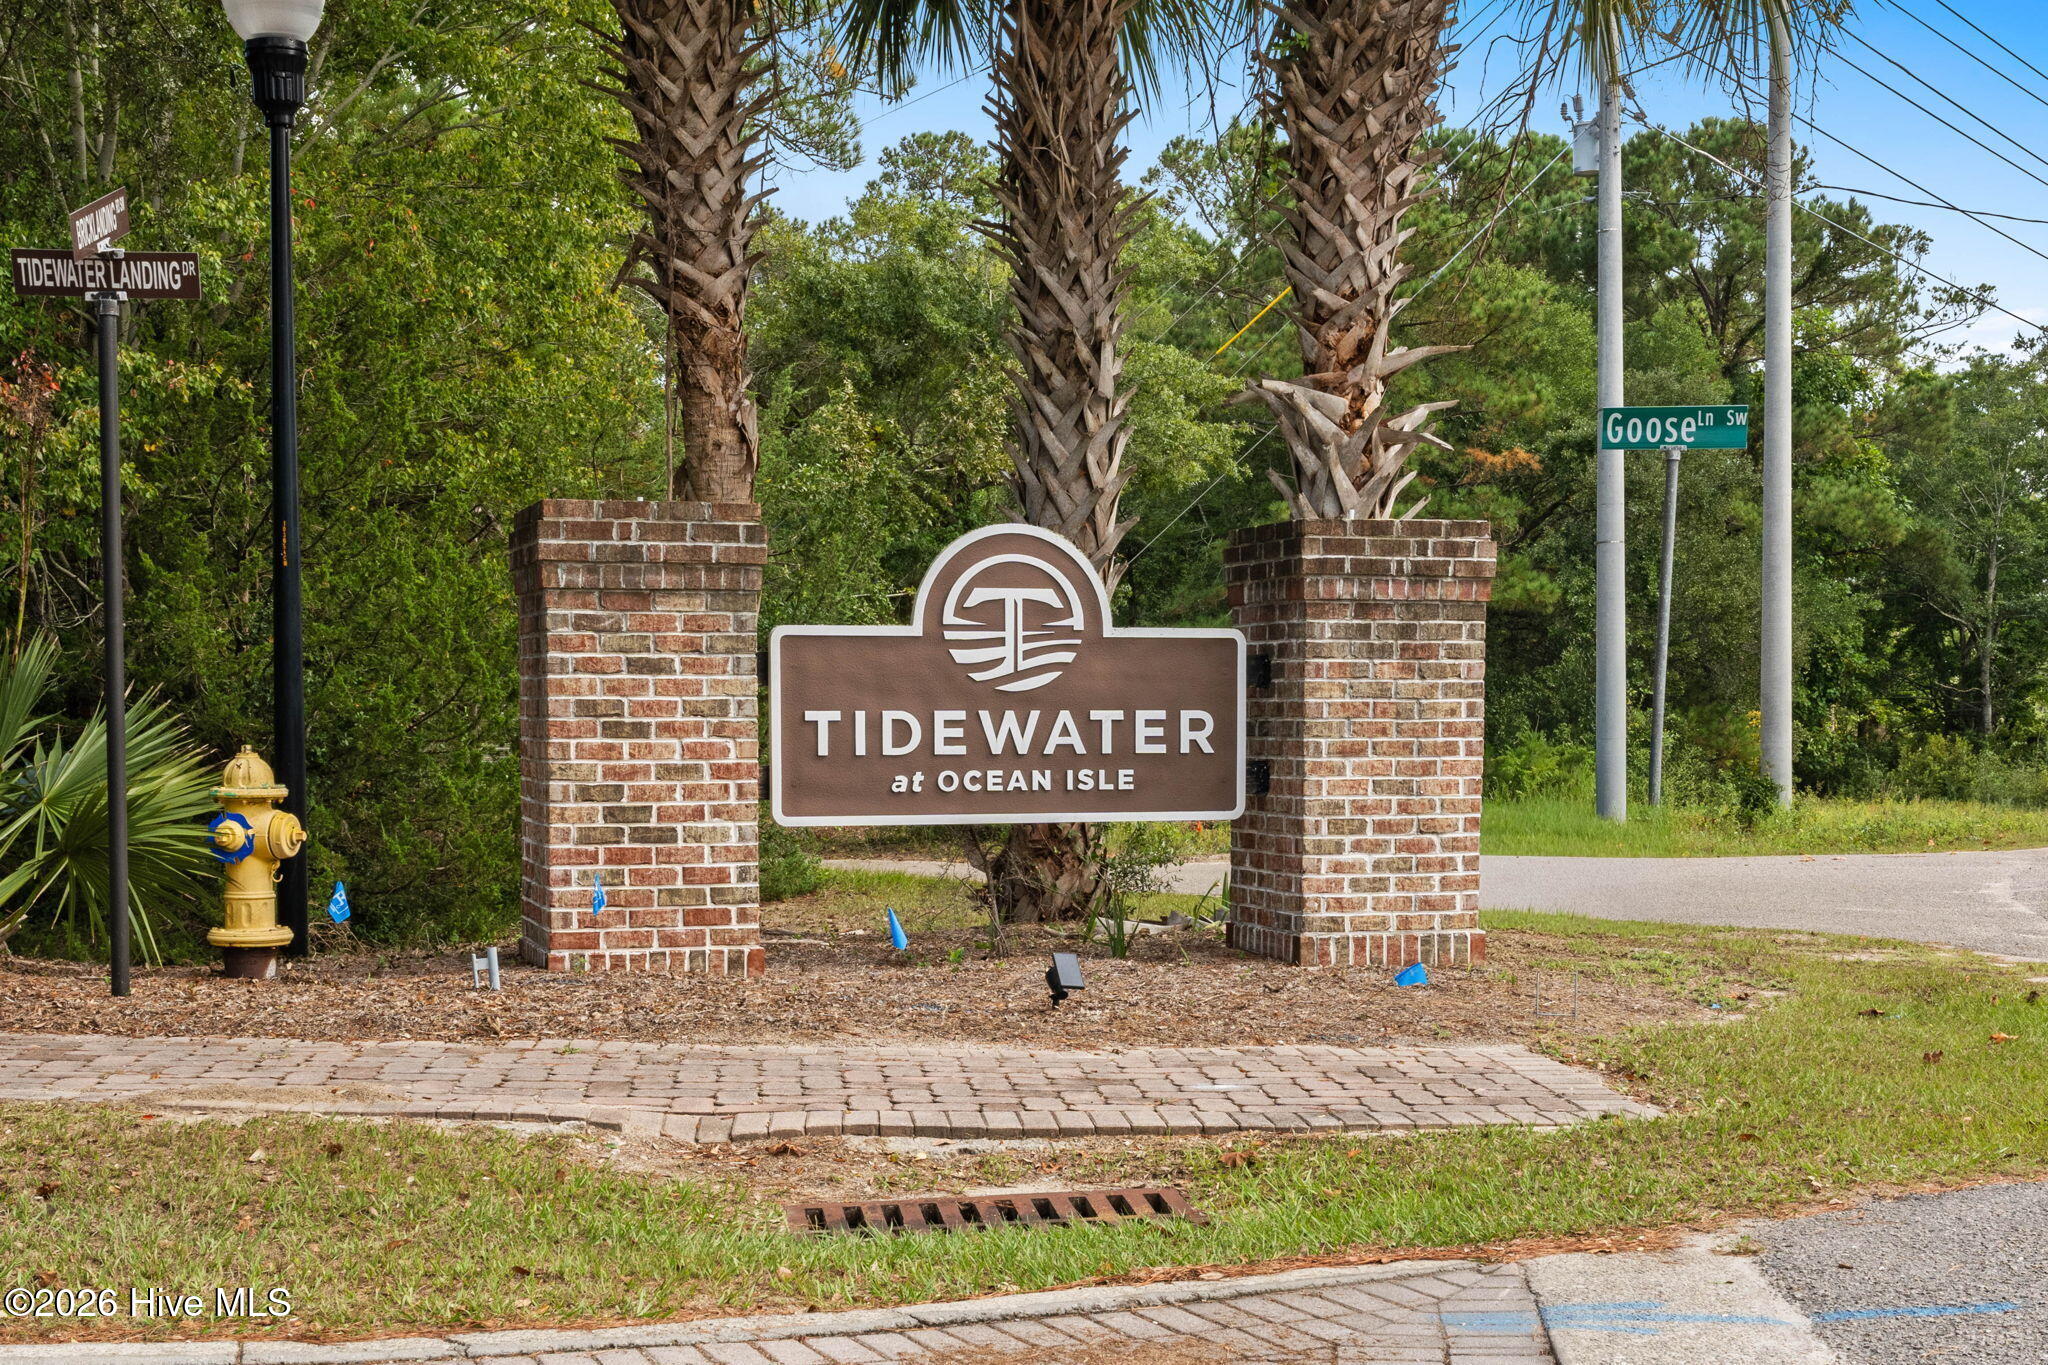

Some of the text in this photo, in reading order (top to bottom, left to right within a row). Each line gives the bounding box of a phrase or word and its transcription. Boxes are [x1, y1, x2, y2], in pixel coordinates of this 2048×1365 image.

[17, 257, 196, 290] TIDEWATER LANDING DR
[1606, 412, 1697, 443] Goose
[1697, 410, 1714, 426] Ln
[804, 709, 1215, 757] TIDEWATER
[891, 768, 1135, 793] at OCEAN ISLE
